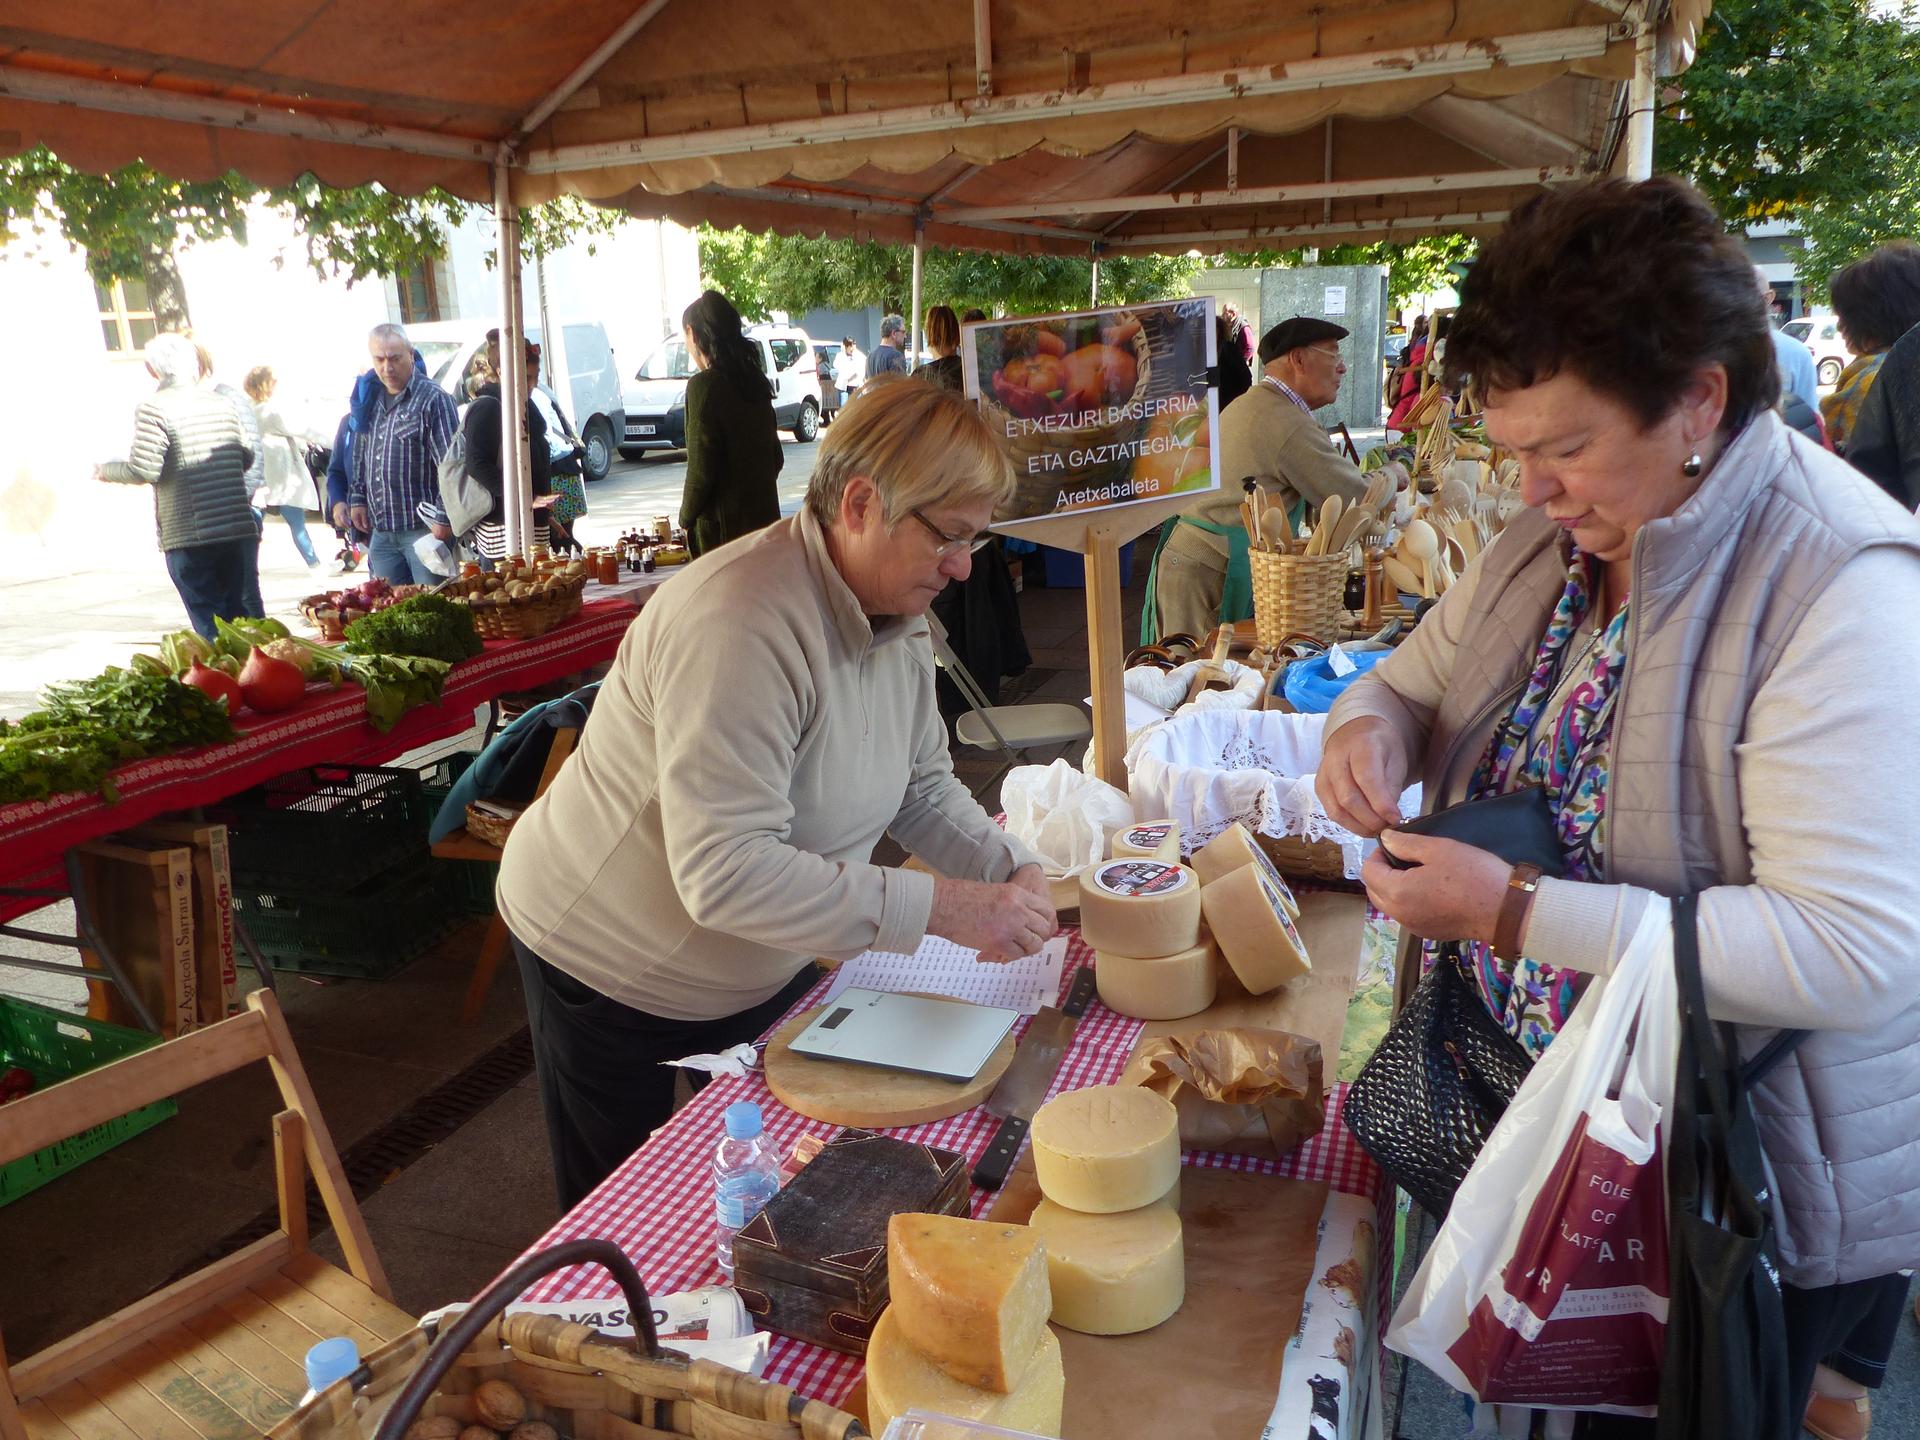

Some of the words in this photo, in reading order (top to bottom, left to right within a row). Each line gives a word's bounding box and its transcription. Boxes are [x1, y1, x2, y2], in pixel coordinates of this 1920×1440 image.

[1005, 409, 1102, 438] ETXEZURI
[1108, 394, 1199, 425] BASERRIA
[1028, 454, 1065, 474] ETA
[1069, 435, 1182, 468] GAZTATEGIA
[1056, 477, 1160, 507] Aretxabaleta
[176, 895, 189, 947] Sarrau
[1589, 1174, 1633, 1200] FOIE
